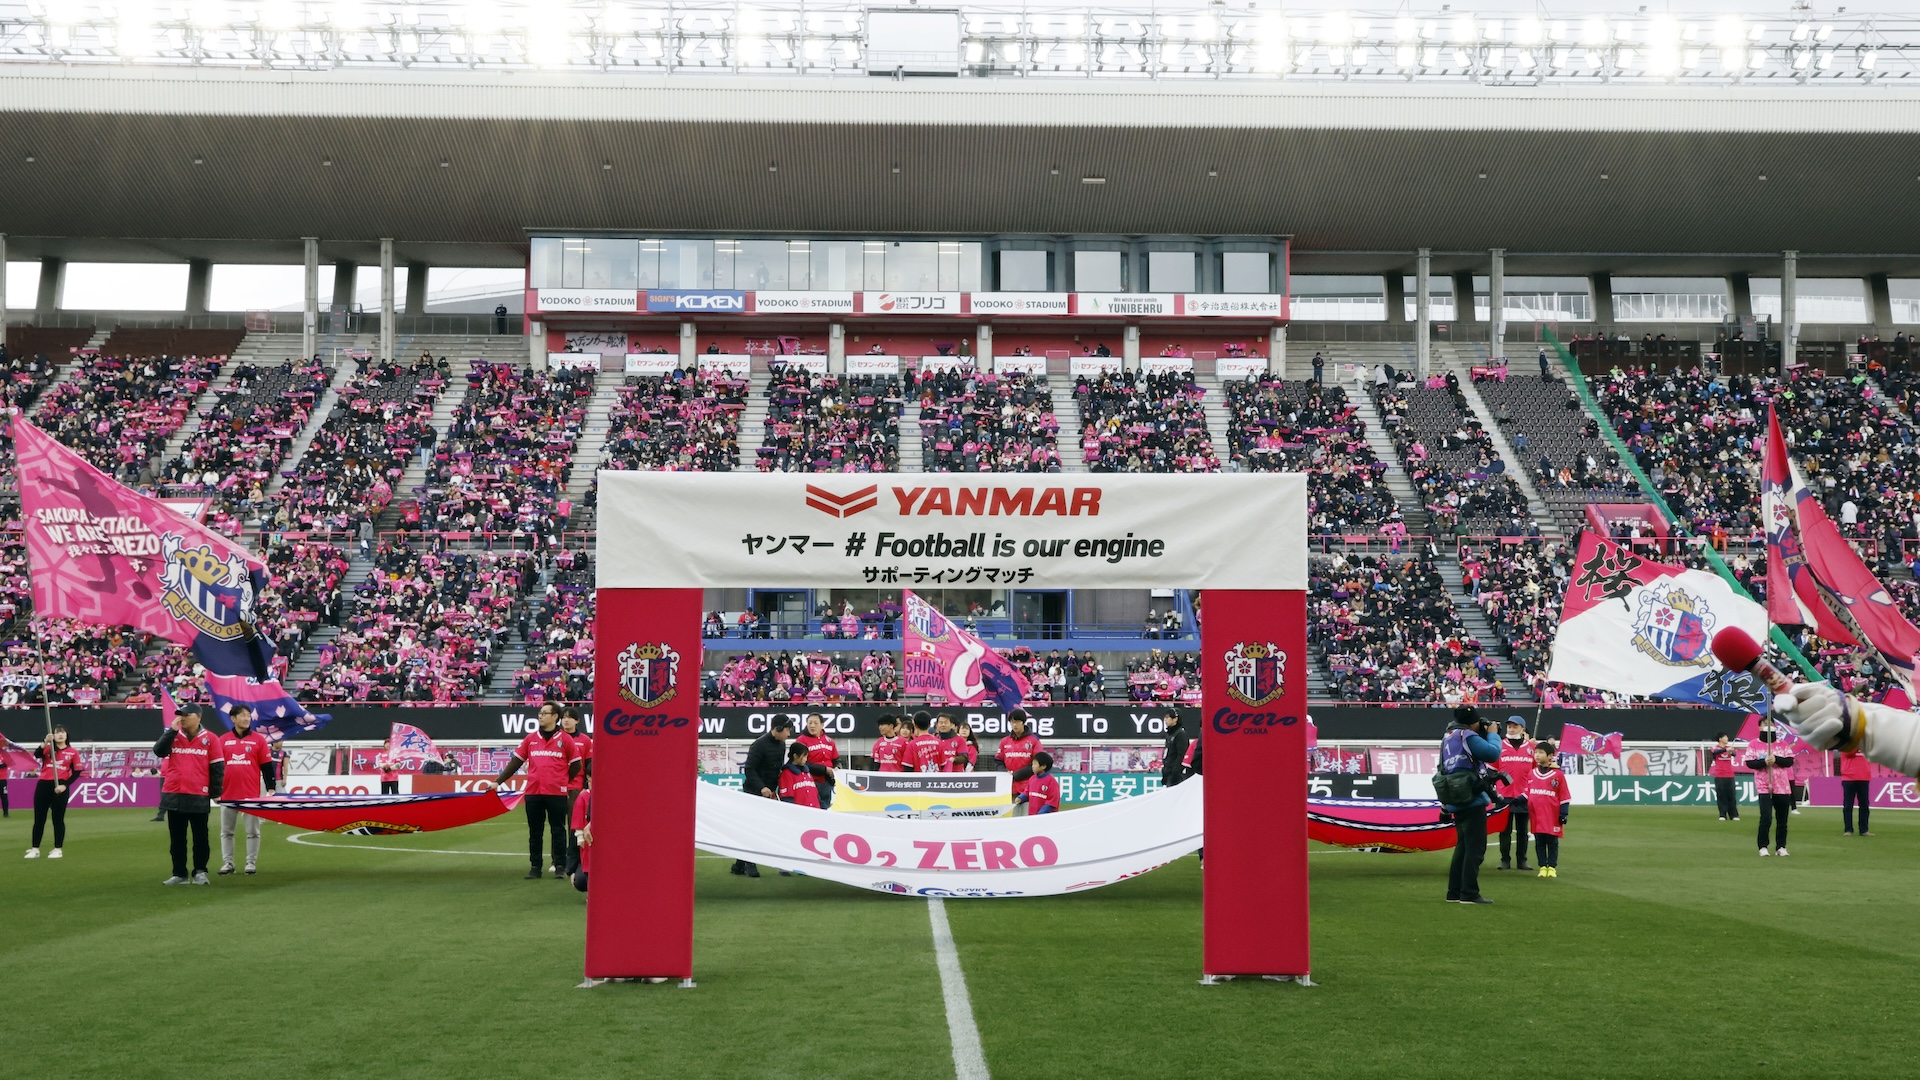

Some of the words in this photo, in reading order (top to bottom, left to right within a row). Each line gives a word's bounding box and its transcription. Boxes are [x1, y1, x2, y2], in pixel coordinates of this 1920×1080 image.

[540, 296, 581, 305] YODOKO
[594, 297, 635, 306] STADIUM
[675, 295, 743, 309] KOKEN
[758, 299, 799, 307] YODOKO
[811, 299, 852, 307] STADIUM
[973, 300, 1013, 308] YODOKO
[1025, 301, 1066, 309] STADIUM
[1108, 303, 1163, 313] YUNIBEHRU
[891, 487, 1102, 516] YANMAR
[37, 507, 89, 524] SAKURA
[43, 524, 76, 544] WE
[75, 524, 109, 542] ARE
[110, 534, 160, 556] REZO
[741, 533, 834, 555] ヤンマー
[845, 532, 867, 557] #
[875, 532, 986, 558] Football
[992, 532, 1016, 558] is
[1022, 538, 1071, 558] our
[1074, 532, 1165, 564] engine
[862, 565, 1035, 584] サポーティングマッチ
[1576, 542, 1643, 612] 桜
[181, 602, 222, 635] CEREZO
[603, 708, 689, 736] Cerezo
[1076, 714, 1109, 733] To
[1212, 706, 1298, 734] Cerezo
[171, 747, 208, 756] YANMAR
[1445, 743, 1451, 756] 1
[926, 781, 979, 789] J.LEAGUE
[1529, 788, 1556, 797] ANMAR
[913, 835, 1058, 870] ZERO
